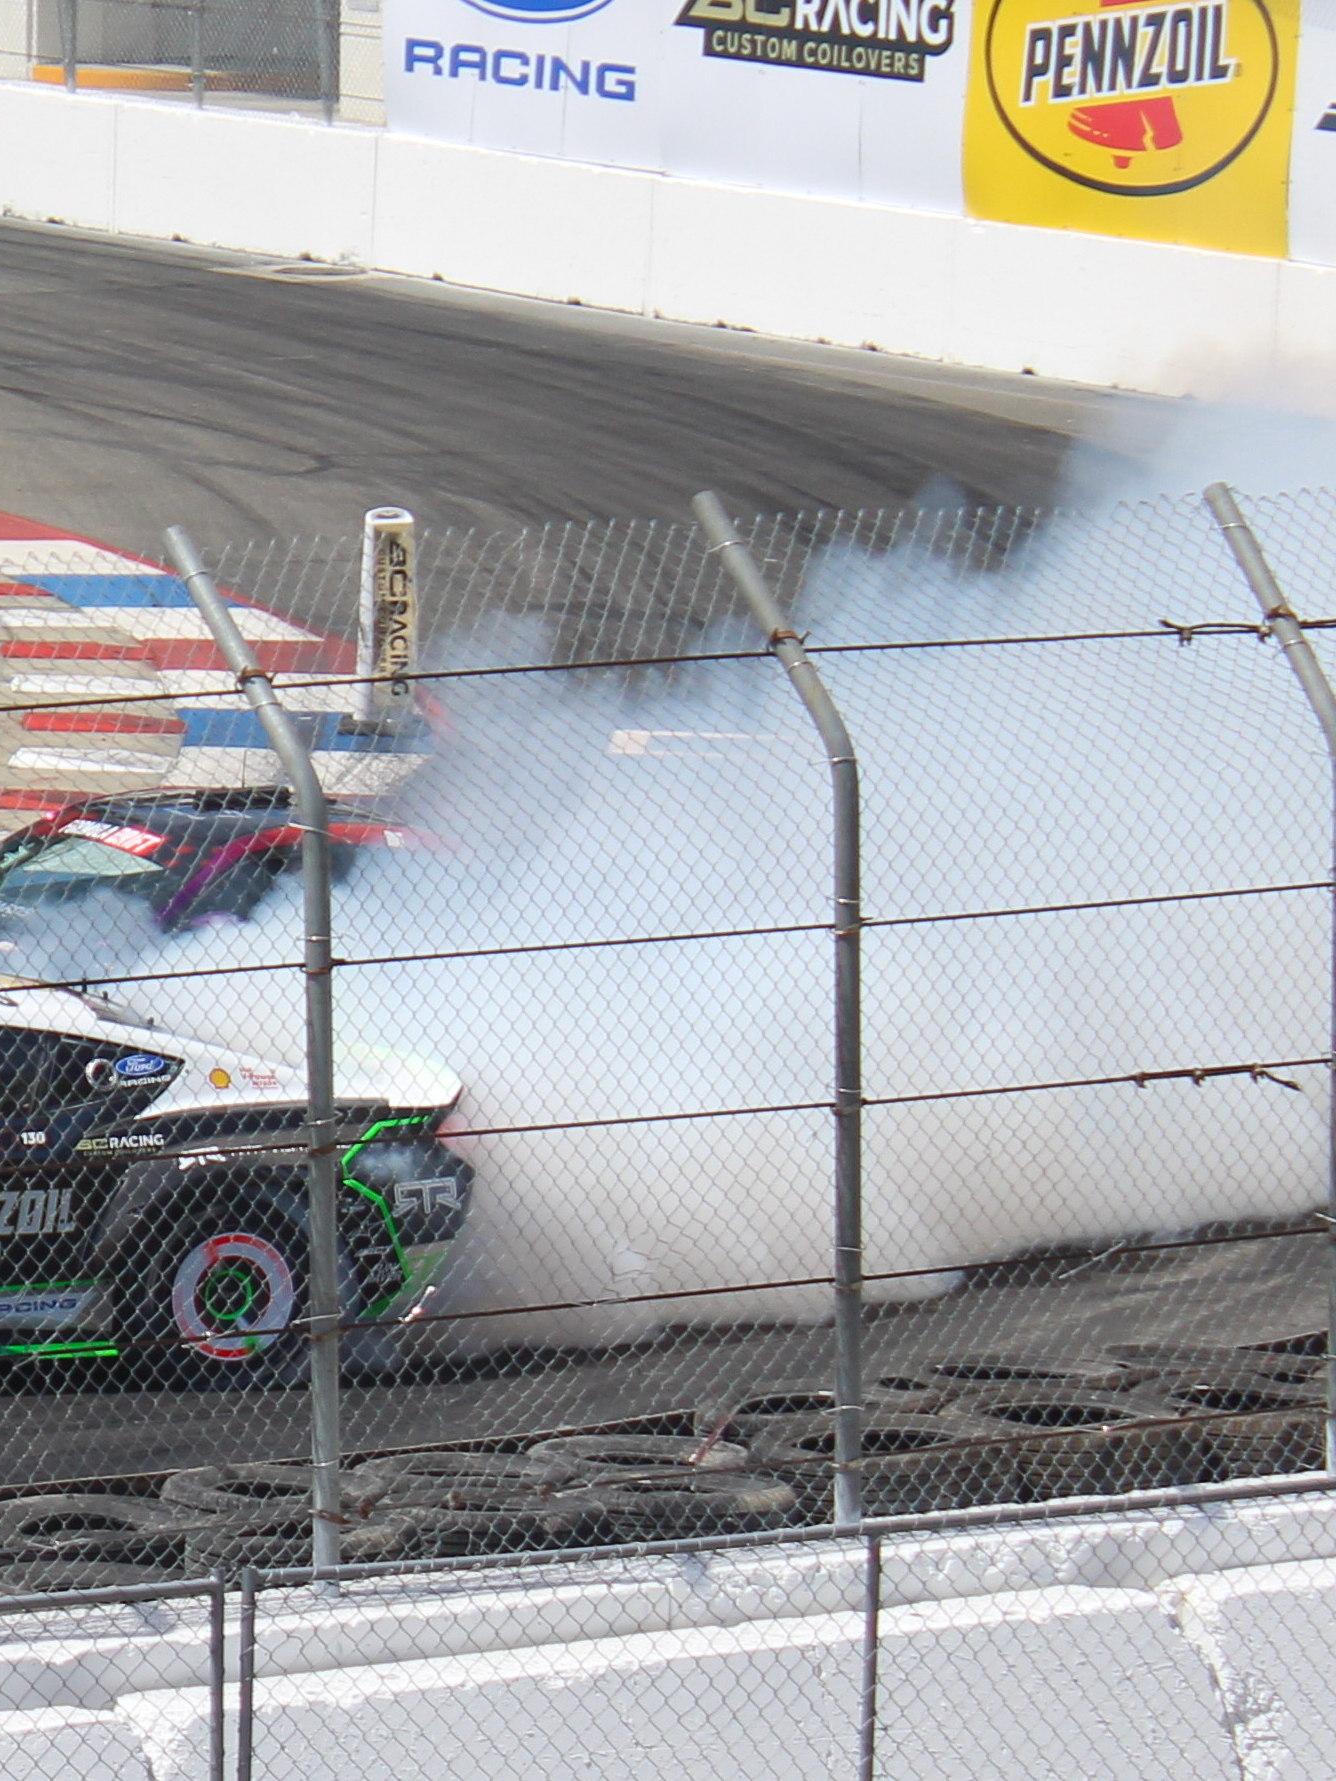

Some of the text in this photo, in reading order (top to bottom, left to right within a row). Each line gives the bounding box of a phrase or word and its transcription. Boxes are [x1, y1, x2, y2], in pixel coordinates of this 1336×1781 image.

[404, 37, 636, 102] RACING
[712, 29, 921, 75] CUSTOM COILOVERS
[1020, 4, 1235, 105] PENNZOIL
[389, 600, 410, 697] RACING
[20, 1131, 46, 1145] 130
[109, 1133, 164, 1149] RACING
